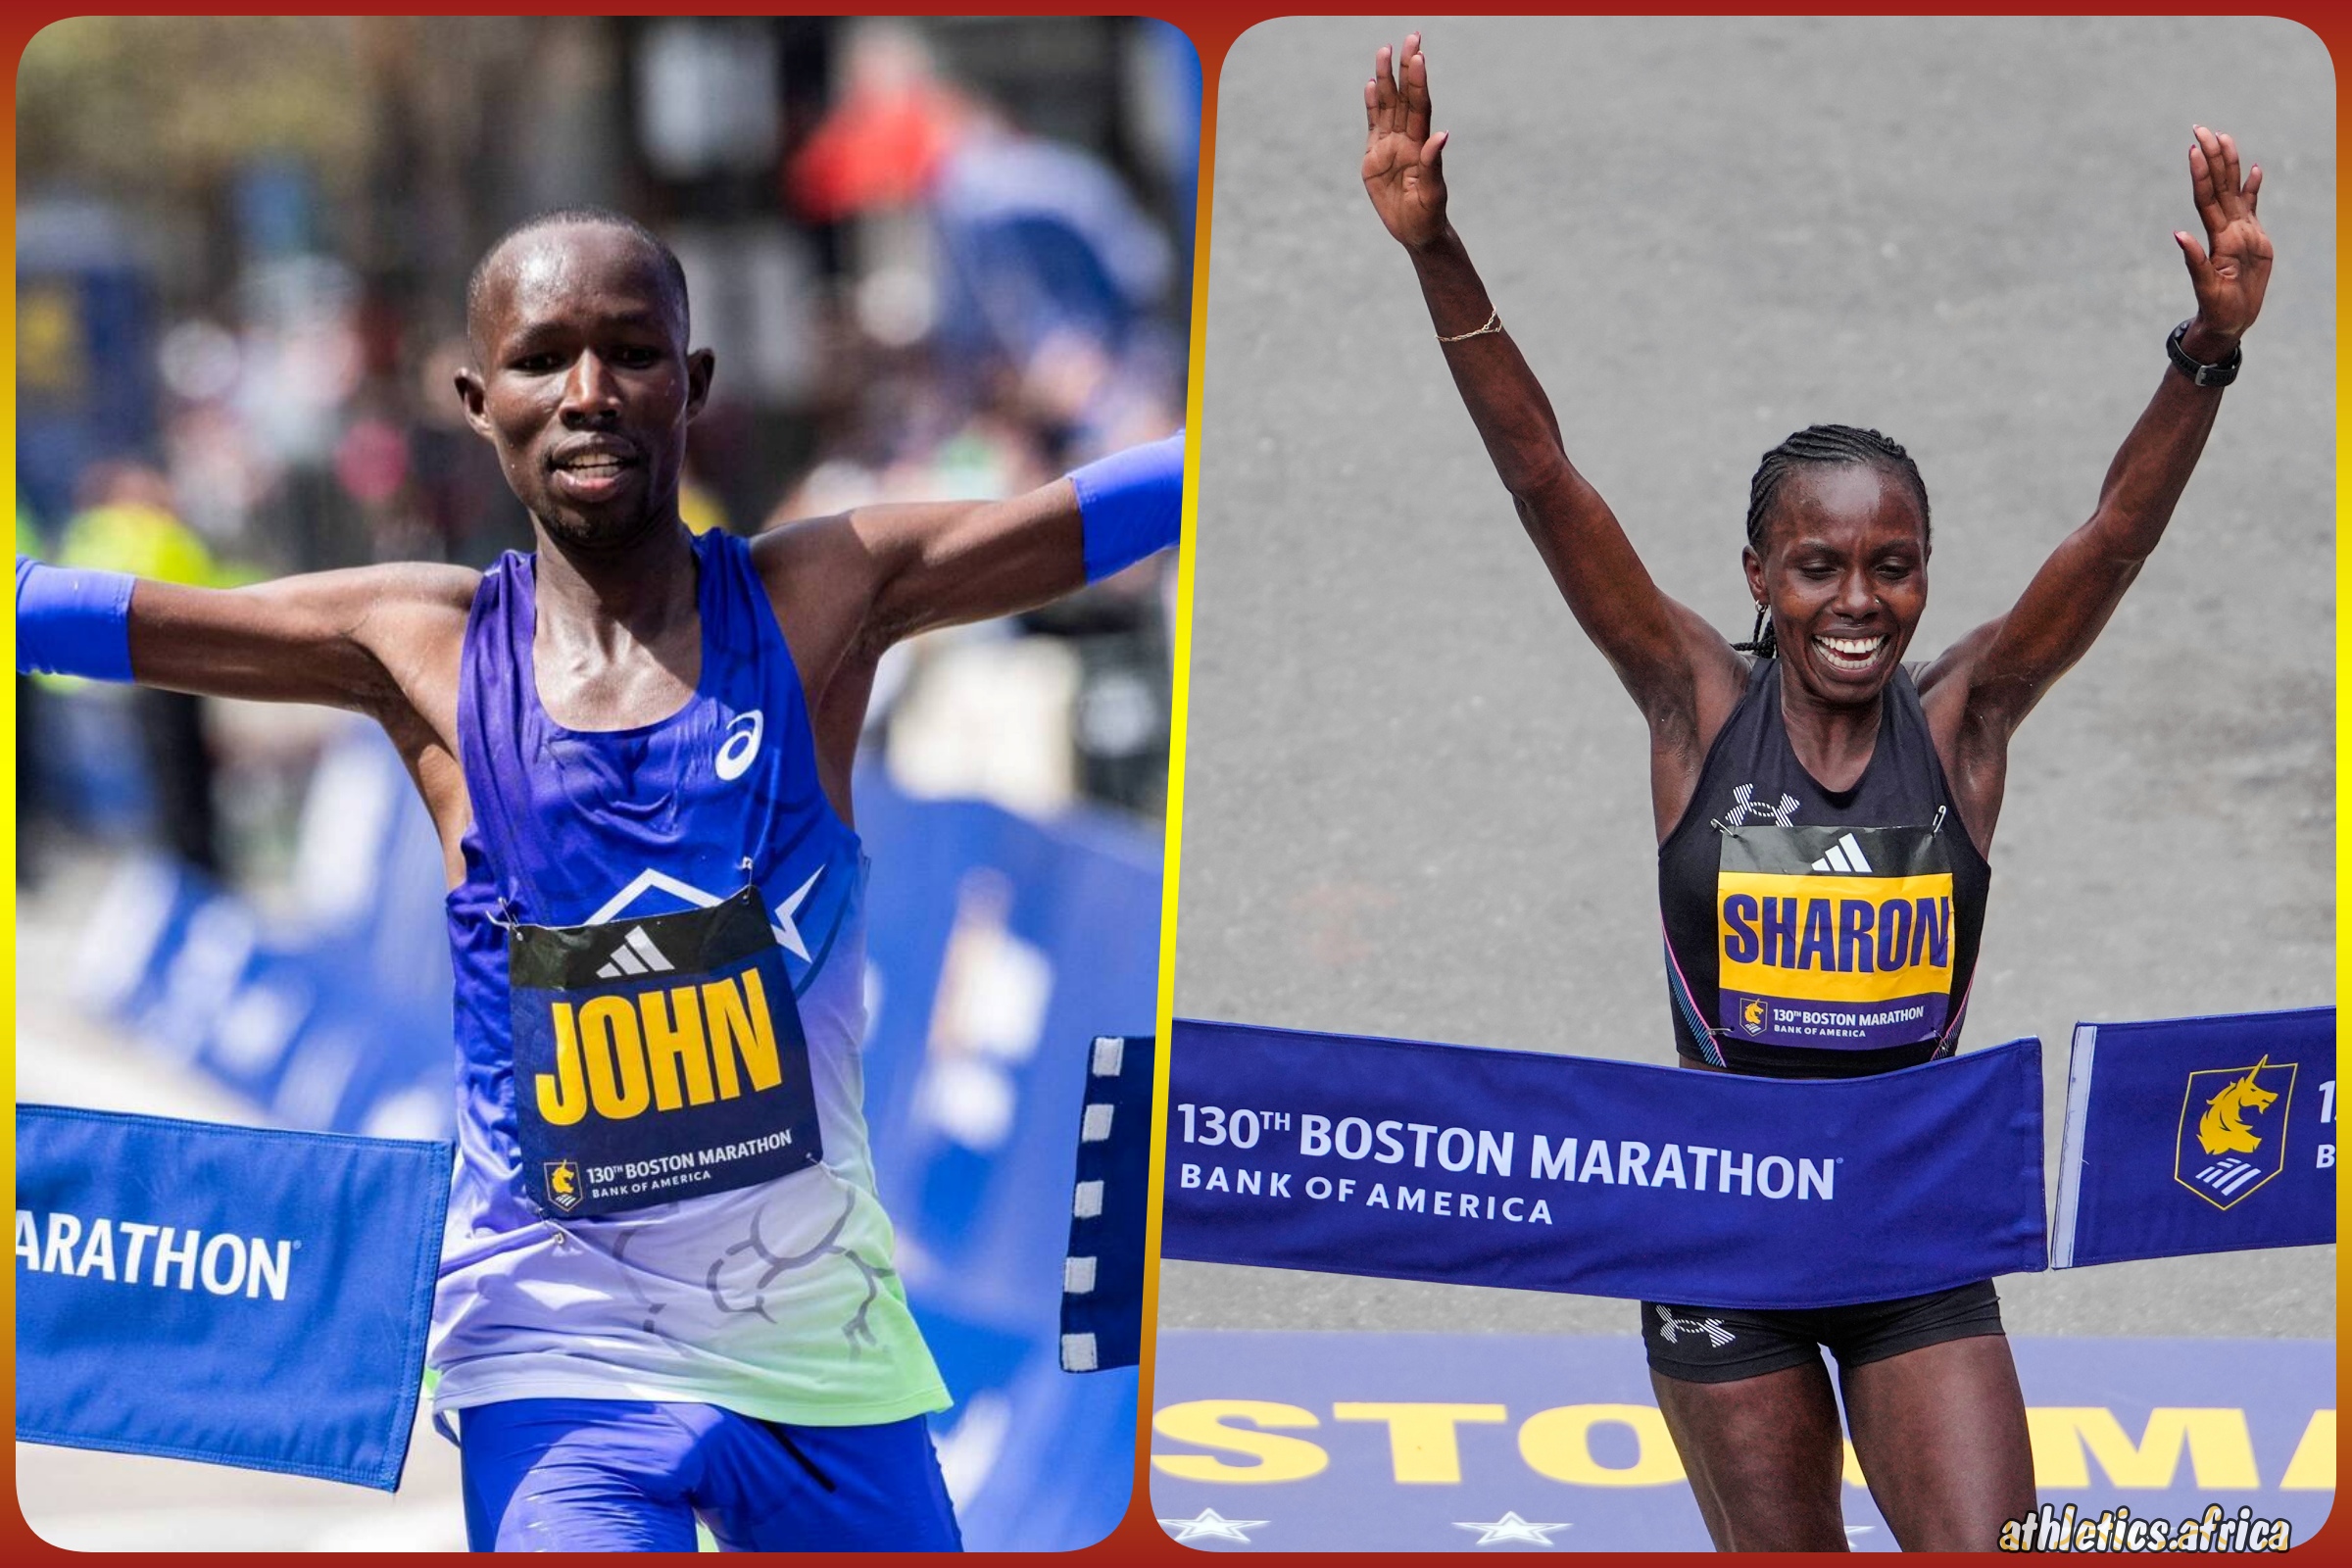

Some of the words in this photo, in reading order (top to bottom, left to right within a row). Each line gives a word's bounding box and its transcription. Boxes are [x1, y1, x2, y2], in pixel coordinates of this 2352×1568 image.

[1722, 893, 1949, 973] SHARON
[534, 966, 783, 1126] JOHN
[1773, 1007, 1801, 1022] 130TH
[1802, 1011, 1855, 1026] BOSTON
[1859, 1005, 1924, 1026] MARATHON
[1774, 1024, 1802, 1035] BANK
[1804, 1026, 1817, 1036] OF
[1819, 1028, 1866, 1038] AMERICA
[586, 1164, 624, 1184] 130TH
[625, 1152, 695, 1180] BOSTON
[698, 1129, 793, 1166] MARATHON
[1177, 1103, 1291, 1150] 130TH
[1299, 1113, 1514, 1177] BOSTON
[1530, 1134, 1835, 1200] MARATHON
[592, 1186, 628, 1199] BANK
[631, 1182, 648, 1194] OF
[651, 1170, 711, 1190] AMERICA
[1180, 1163, 1292, 1199] BANK
[1304, 1176, 1356, 1202] OF
[1366, 1183, 1552, 1225] AMERICA
[1150, 1398, 1868, 1488] STO
